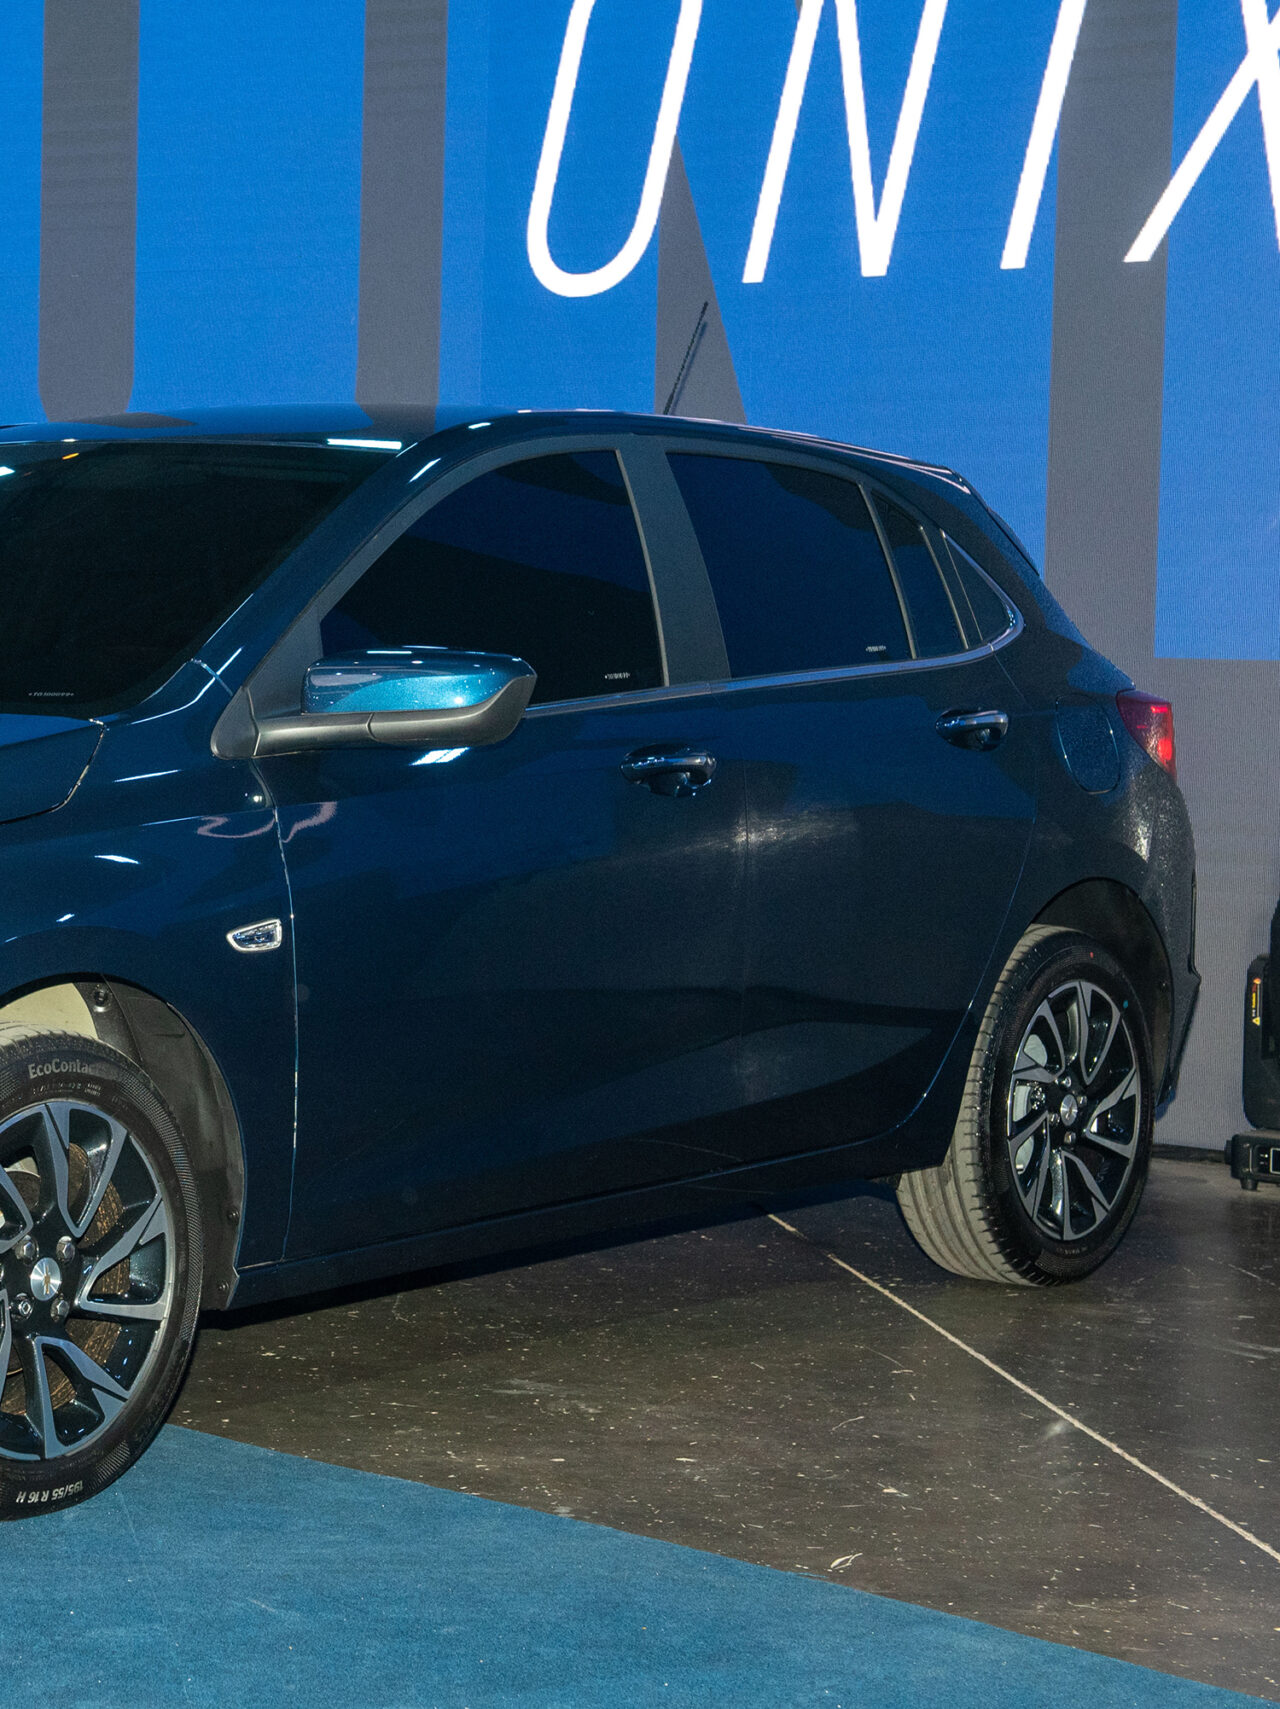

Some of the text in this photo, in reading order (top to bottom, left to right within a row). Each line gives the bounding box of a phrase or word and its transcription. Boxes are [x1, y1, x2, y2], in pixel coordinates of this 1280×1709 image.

[15, 1480, 84, 1504] 195/55 R 16 H
